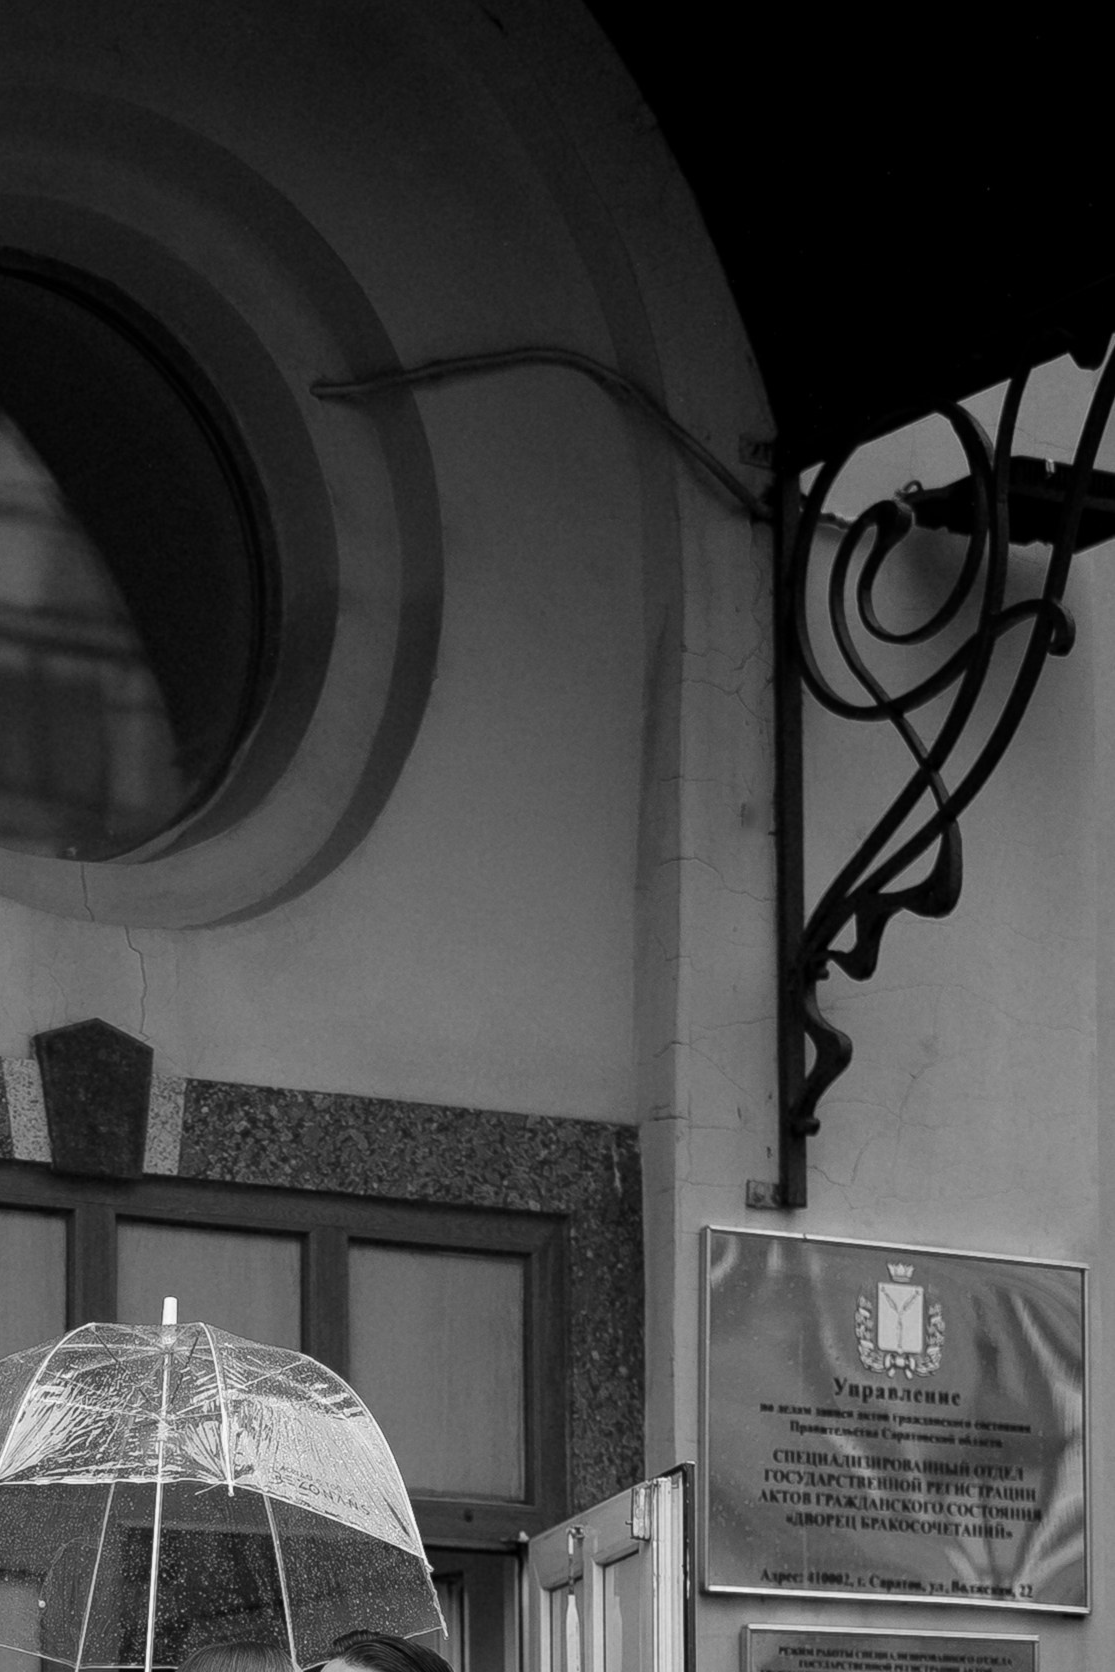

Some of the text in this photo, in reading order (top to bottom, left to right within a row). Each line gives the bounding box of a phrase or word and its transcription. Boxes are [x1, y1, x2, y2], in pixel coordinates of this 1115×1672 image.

[833, 1377, 961, 1406] Управление
[789, 1420, 878, 1439] Правительства
[772, 1448, 1024, 1482] СПЕЦИАЛИЗИРОВАННЫЙ ОТДЕЛ
[764, 1468, 1036, 1502] ГОСУДАРСТВЕННОЙ РЕГИСТРАЦИИ
[758, 1488, 1042, 1522] АКТОВ ГРАЖДАНСКОГО СОСТОЯНИЯ
[786, 1511, 1014, 1540] «ДВОРЕЦ БРАКОСОЧЕТАНИЙ»
[760, 1568, 804, 1588] Адрес:
